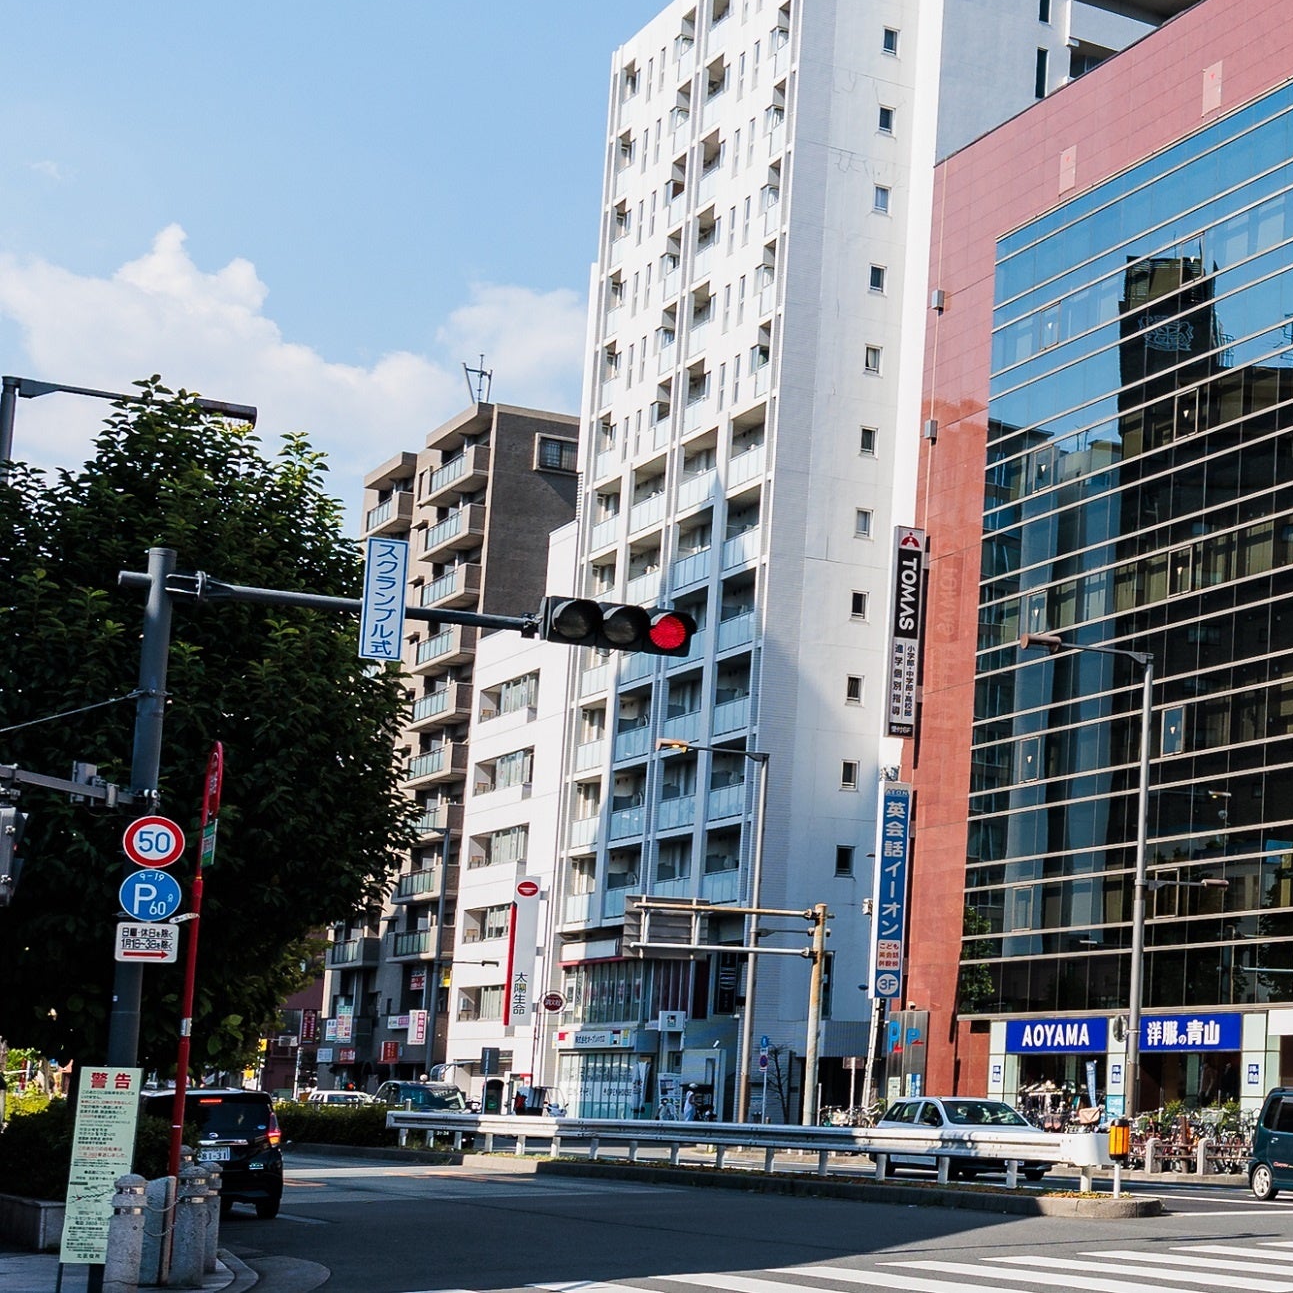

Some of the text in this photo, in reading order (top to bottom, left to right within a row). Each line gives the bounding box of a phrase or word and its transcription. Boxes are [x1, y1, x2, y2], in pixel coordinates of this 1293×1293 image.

[369, 543, 403, 656] スクランブル式
[898, 558, 918, 631] TOMAS
[138, 830, 171, 853] 50
[139, 872, 165, 882] 9-19
[881, 801, 906, 936] 英会話イーオン
[133, 883, 158, 915] P
[149, 901, 167, 916] 60
[879, 942, 899, 950] こども
[879, 951, 899, 959] 英会話
[512, 972, 529, 1016] 太陽生命
[879, 978, 897, 991] 3F
[1021, 1023, 1090, 1048] AOYAMA
[1147, 1019, 1221, 1047] 洋服の青山
[91, 1072, 131, 1089] 警告
